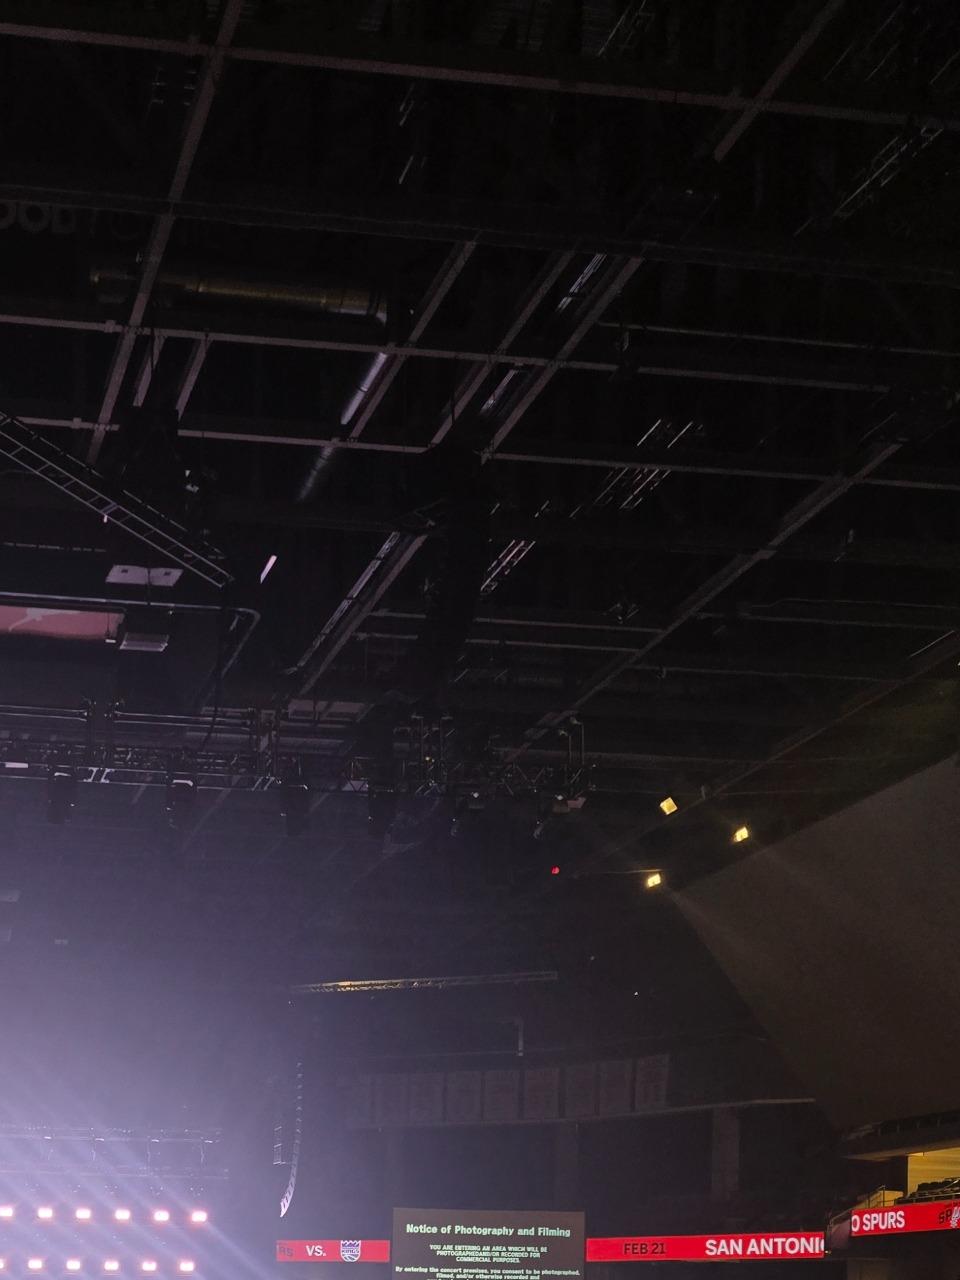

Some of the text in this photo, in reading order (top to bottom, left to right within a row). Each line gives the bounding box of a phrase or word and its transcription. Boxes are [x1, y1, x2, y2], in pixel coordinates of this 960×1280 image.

[862, 1210, 906, 1231] SPURS
[407, 1224, 570, 1237] Notice of Photography and Filming
[306, 1245, 326, 1256] VS.
[624, 1242, 666, 1255] FEB 21
[705, 1239, 743, 1256] SAN
